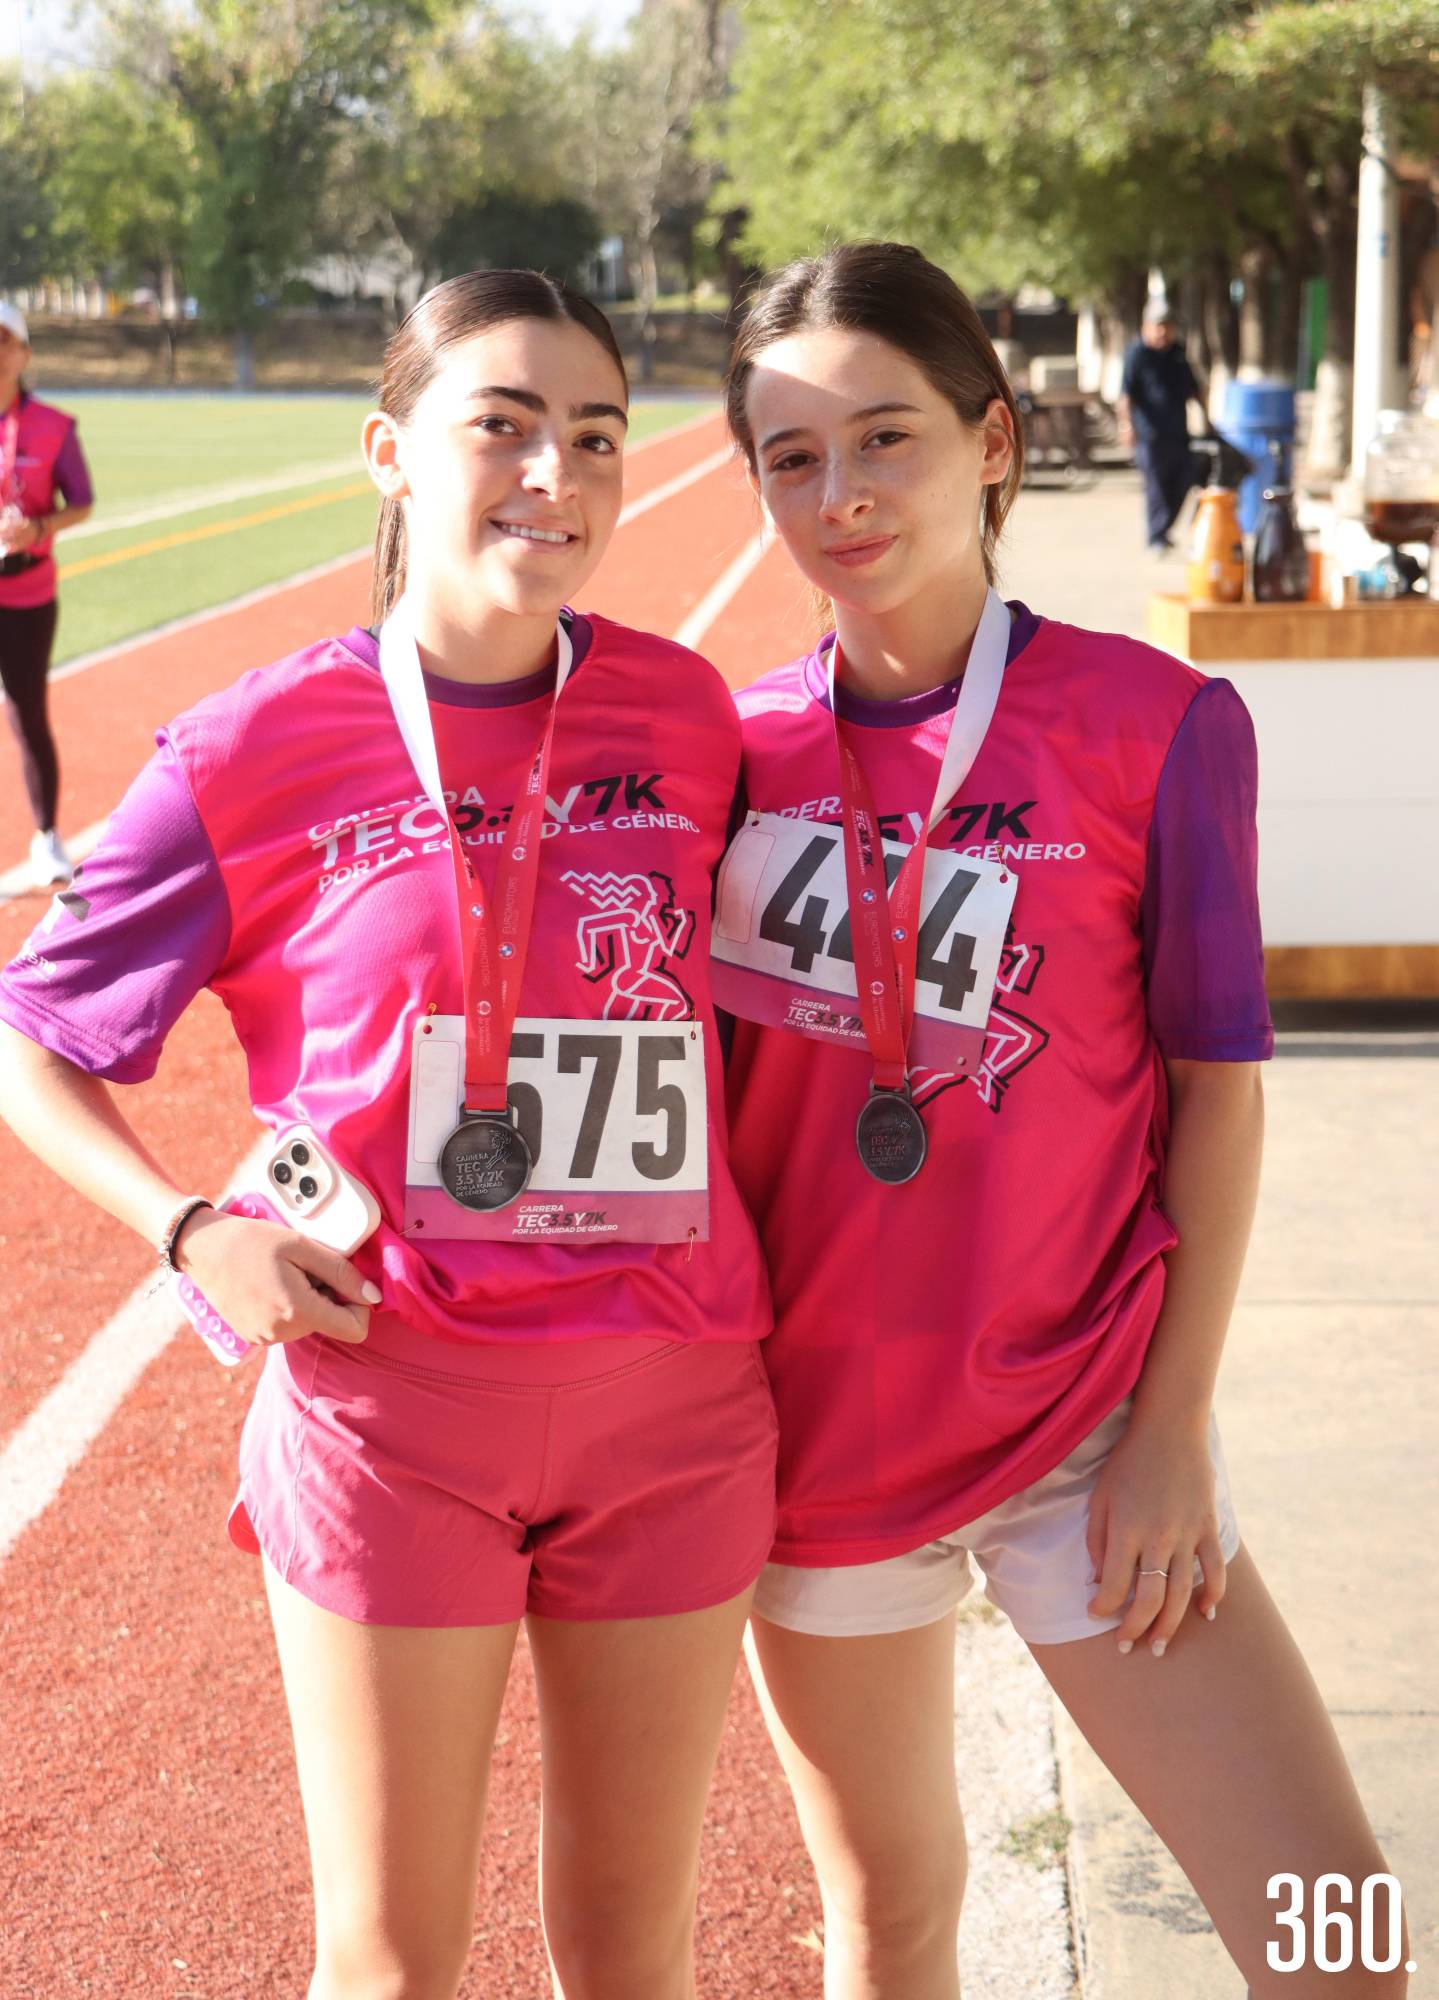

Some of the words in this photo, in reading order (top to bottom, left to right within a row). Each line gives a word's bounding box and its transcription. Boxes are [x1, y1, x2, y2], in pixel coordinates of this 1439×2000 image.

[319, 858, 370, 893] POR
[377, 846, 414, 867] LA
[568, 820, 607, 834] DE
[612, 809, 700, 833] GÉNERO
[791, 998, 831, 1012] CARRERA
[783, 1017, 796, 1025] POR
[797, 1020, 805, 1028] LA
[805, 1022, 839, 1034] EQUIDAD
[456, 1161, 481, 1174] TEC
[519, 1204, 564, 1213] CARRERA
[541, 1226, 575, 1235] EQUIDAD
